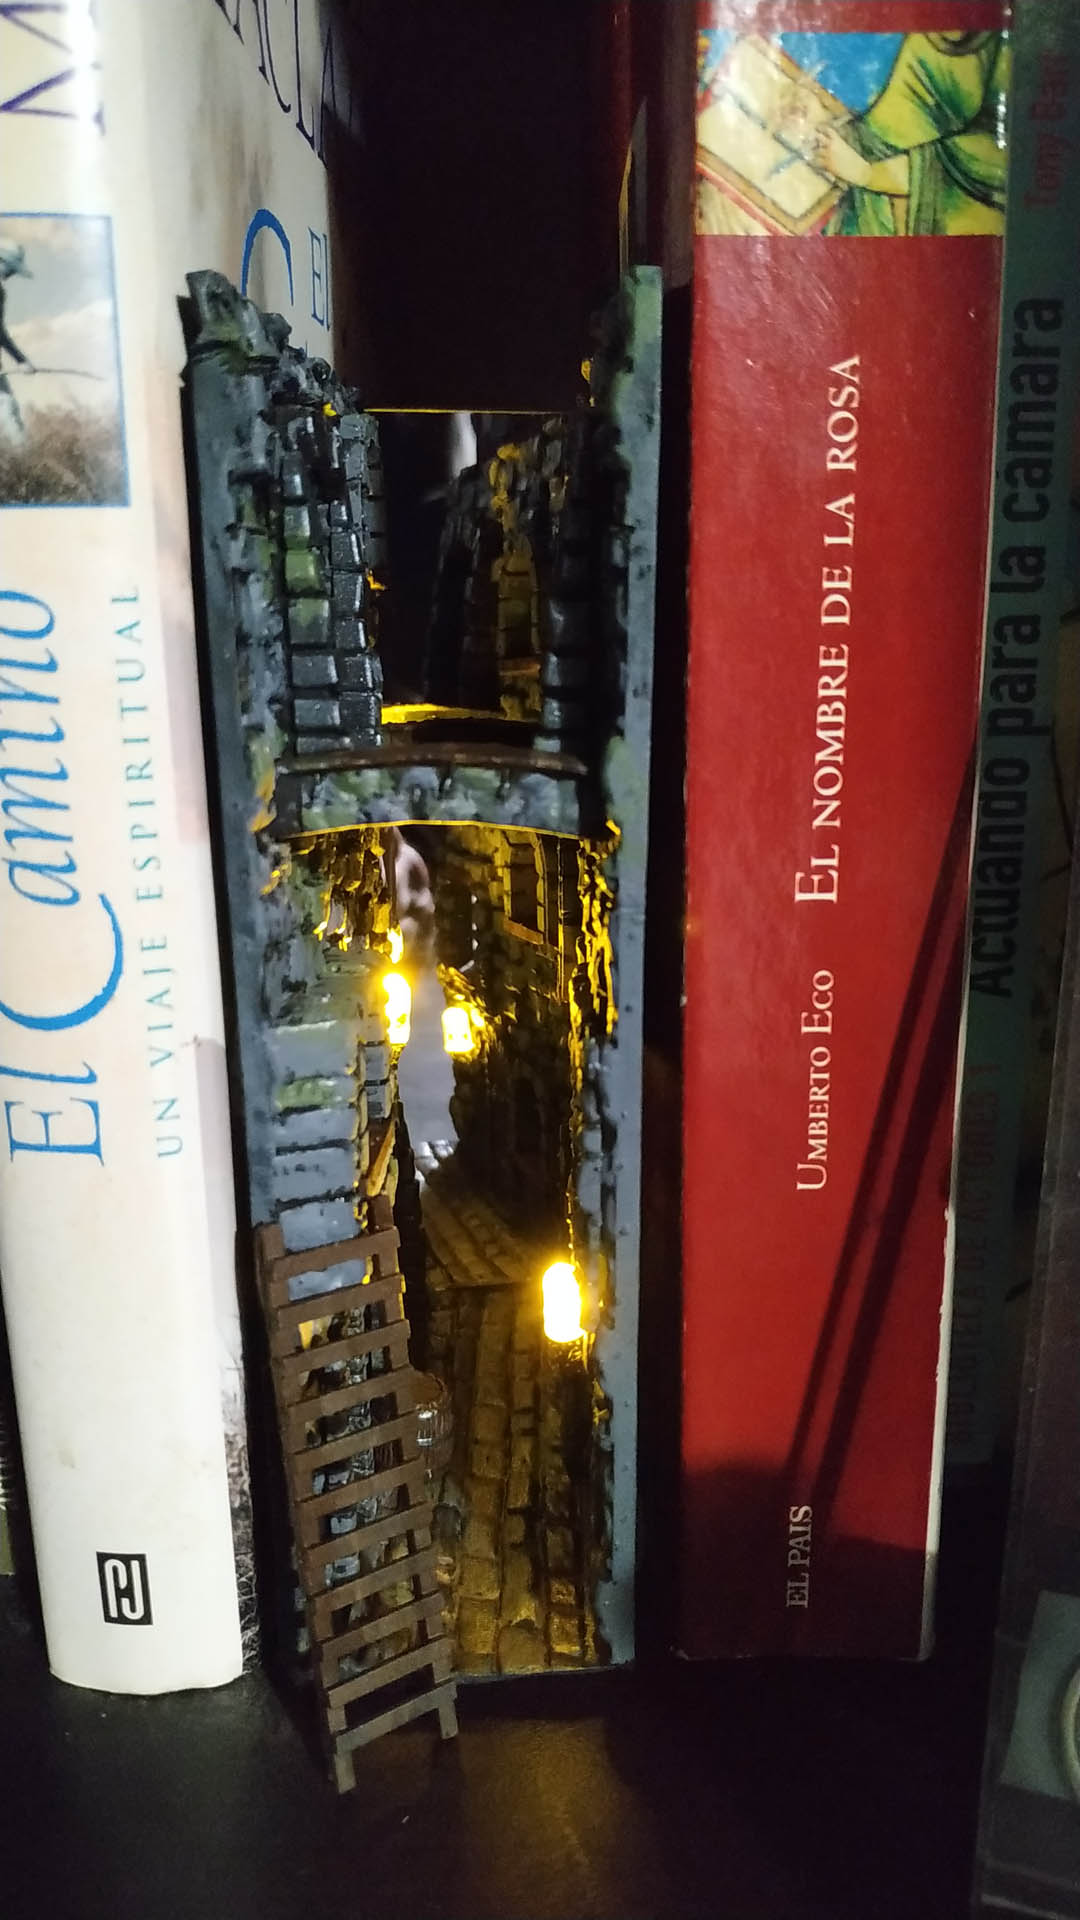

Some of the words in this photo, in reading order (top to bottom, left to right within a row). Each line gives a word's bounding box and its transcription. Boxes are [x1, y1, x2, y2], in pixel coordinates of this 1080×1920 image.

[826, 355, 861, 471] ROSA
[824, 493, 856, 547] LA
[991, 546, 1047, 593] la
[820, 564, 853, 626] DE
[984, 613, 1054, 738] para
[110, 583, 164, 901] ESPIRITUAL
[812, 643, 850, 830] NOMBRE
[970, 757, 1030, 998] Actuando
[140, 934, 175, 1067] VIAJE
[0, 1061, 104, 1166] El
[153, 1098, 183, 1158] UN
[787, 1505, 813, 1568] PAIS
[786, 1573, 810, 1608] EL
